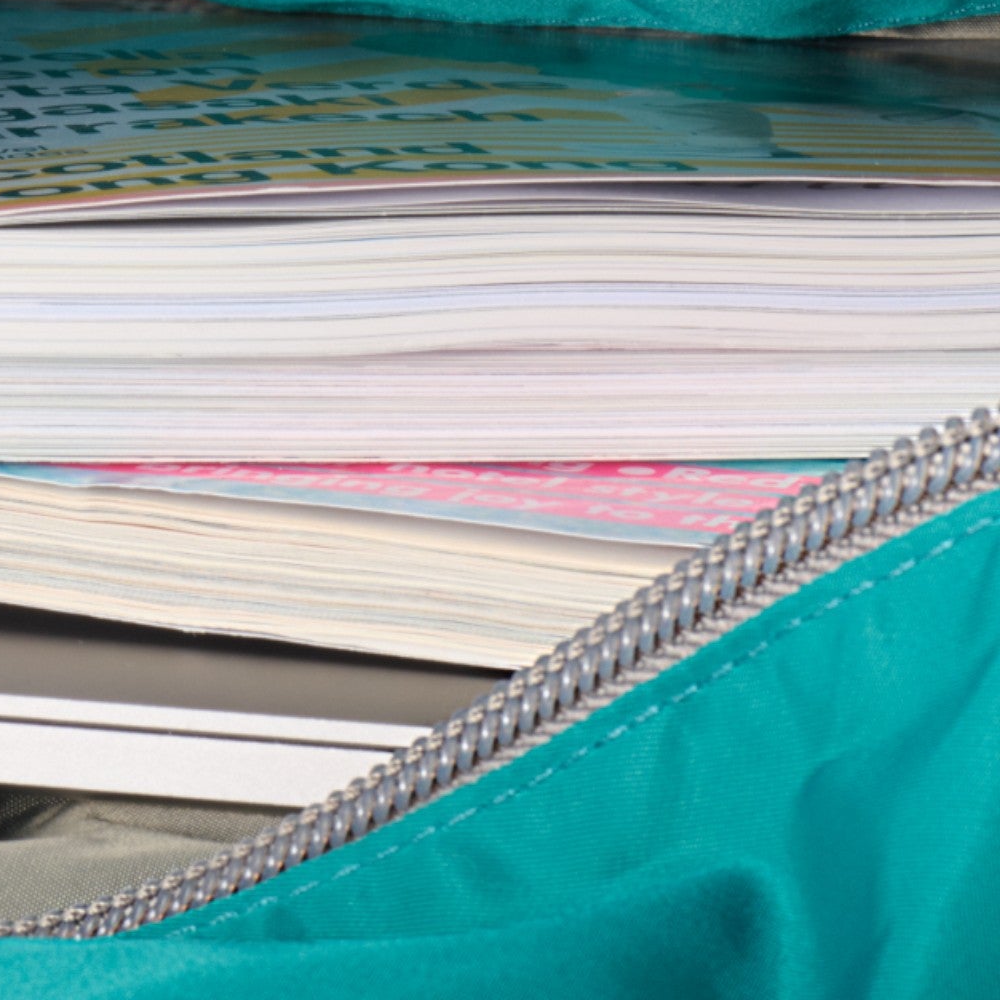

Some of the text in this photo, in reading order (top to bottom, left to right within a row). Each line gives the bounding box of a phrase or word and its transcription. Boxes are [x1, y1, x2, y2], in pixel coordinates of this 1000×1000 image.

[166, 77, 570, 91] Verde
[312, 159, 698, 175] Kong
[386, 464, 570, 488] hotel
[584, 485, 754, 507] style
[446, 488, 560, 511] joy
[585, 504, 655, 521] to
